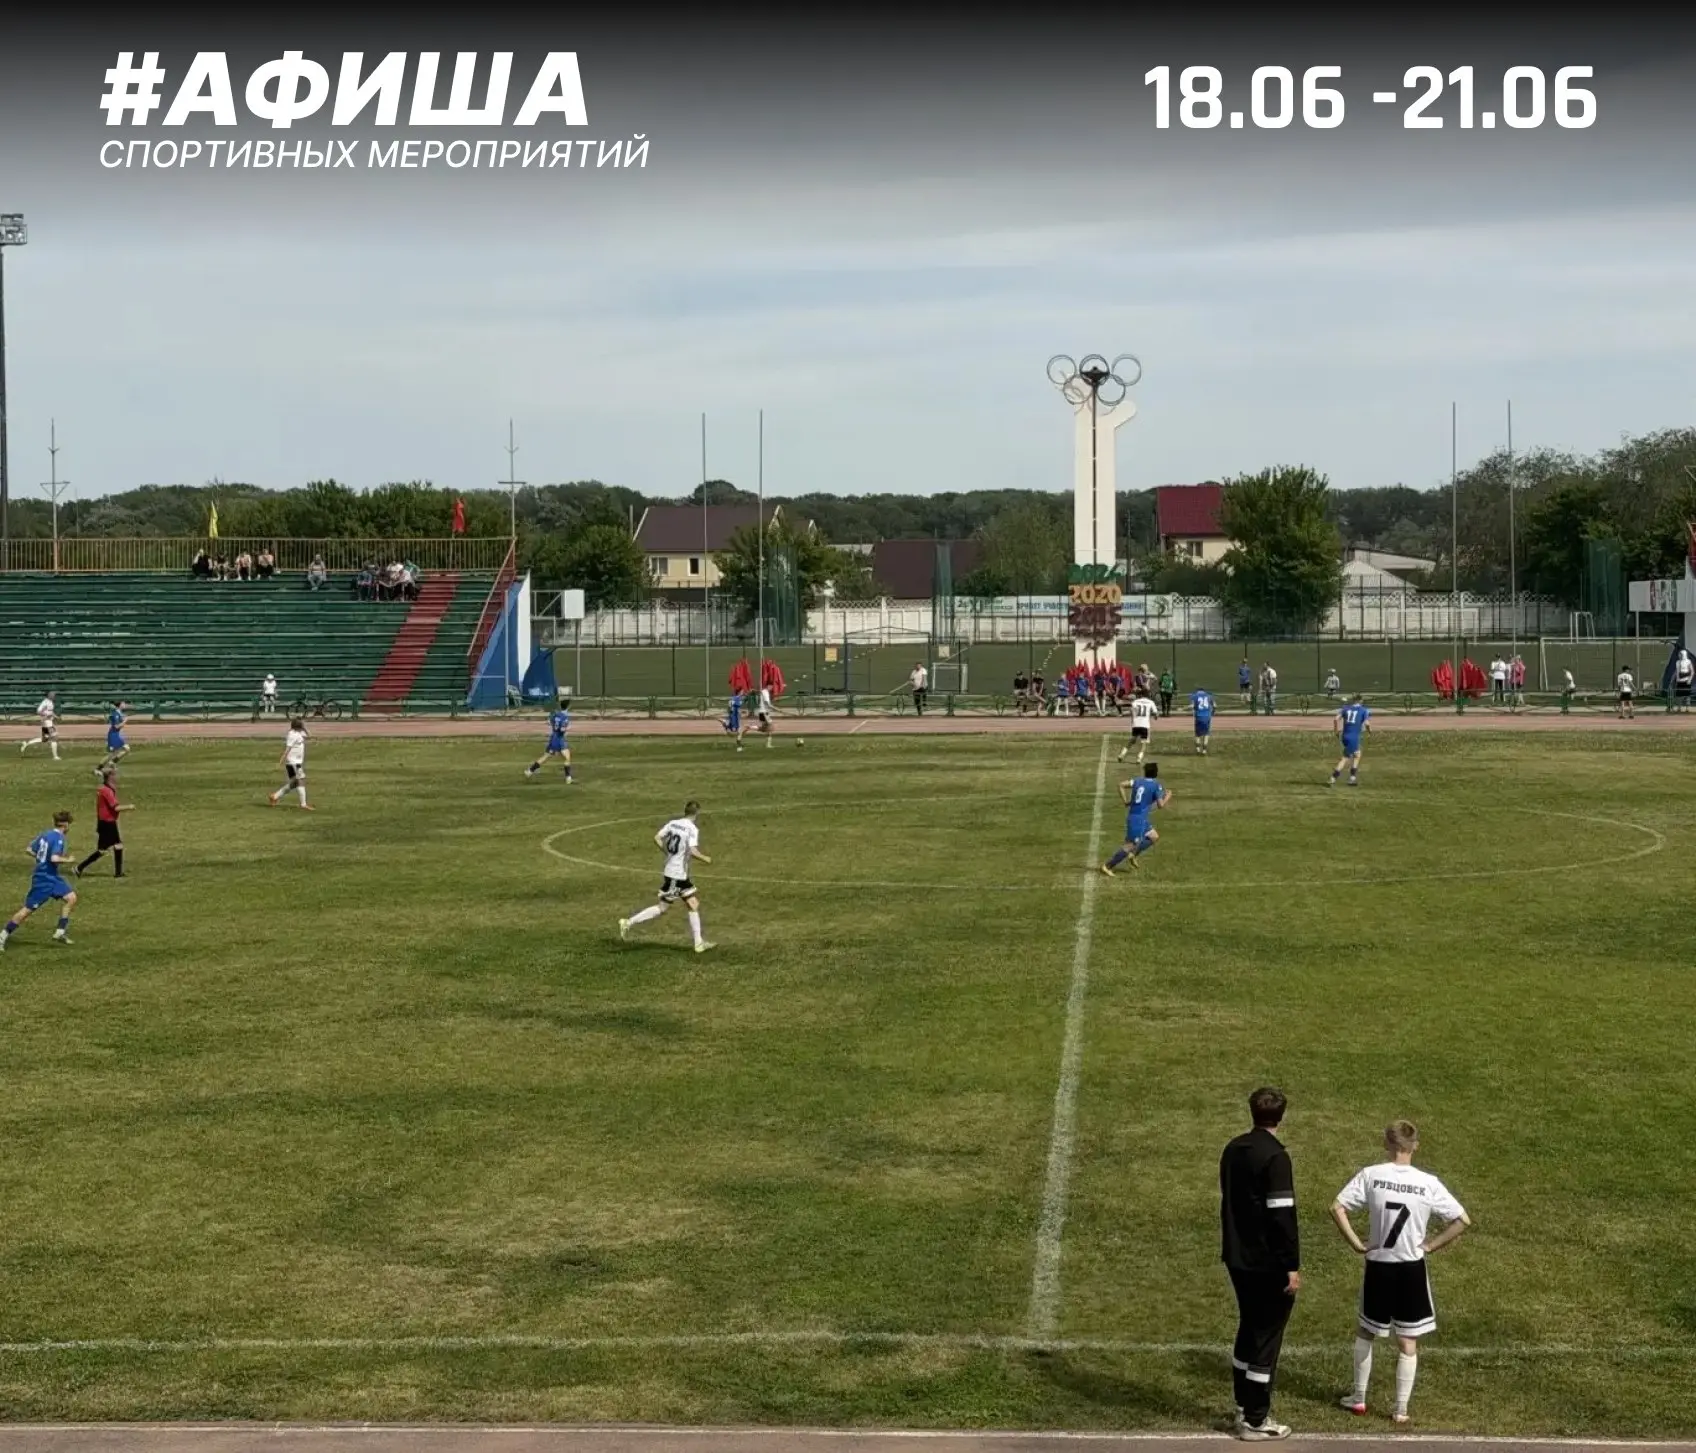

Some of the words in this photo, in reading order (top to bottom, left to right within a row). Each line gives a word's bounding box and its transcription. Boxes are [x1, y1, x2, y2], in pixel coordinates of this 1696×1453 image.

[1068, 585, 1122, 604] 2020
[1197, 697, 1209, 709] 24
[1347, 710, 1358, 723] 11
[1135, 786, 1145, 804] 8
[1373, 1180, 1426, 1196] РУБЦОВСК
[1383, 1201, 1411, 1249] 7
